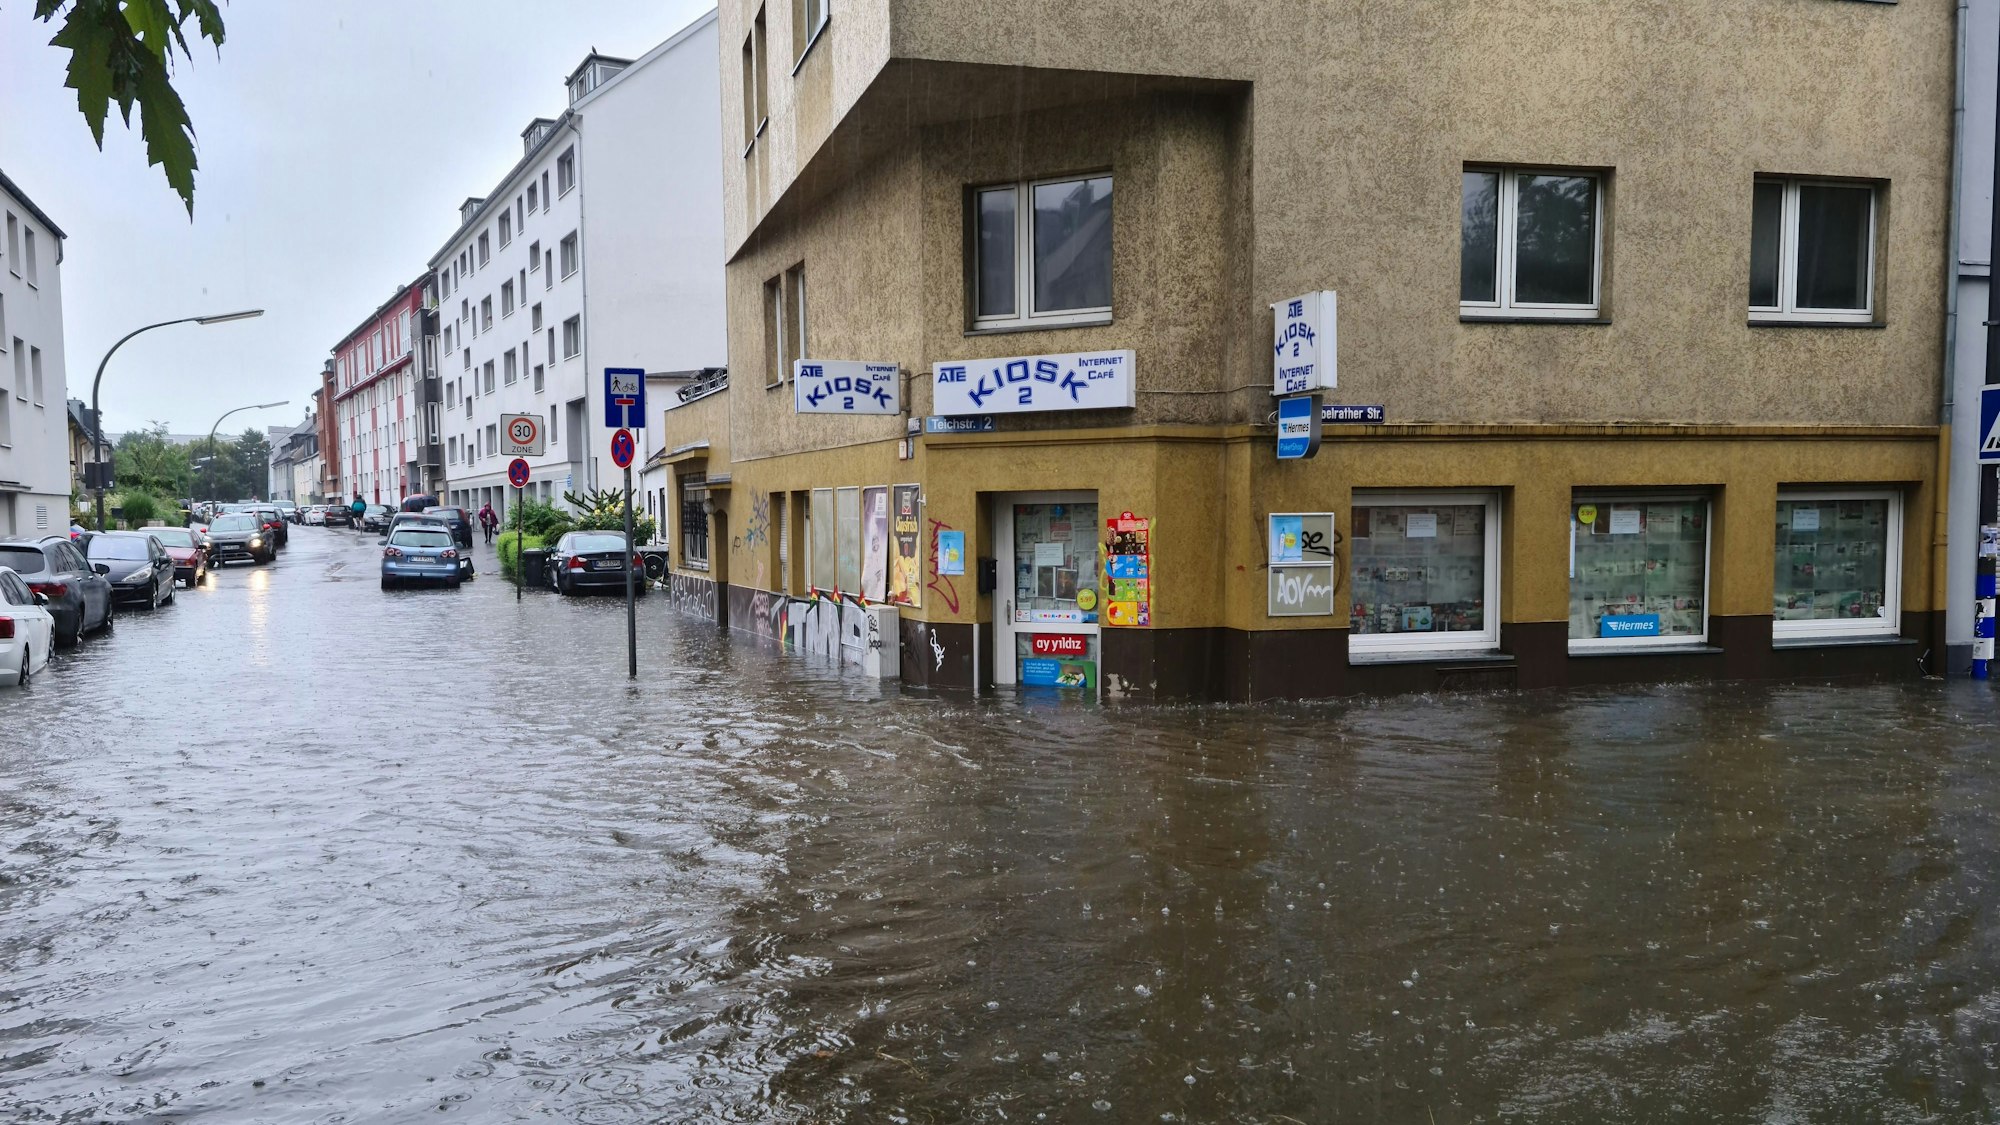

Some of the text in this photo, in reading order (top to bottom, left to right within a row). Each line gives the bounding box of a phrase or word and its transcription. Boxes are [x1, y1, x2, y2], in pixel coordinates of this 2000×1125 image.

[1287, 299, 1303, 319] ATE
[1275, 322, 1316, 357] KIOSK
[1293, 342, 1300, 357] 2
[1078, 356, 1124, 367] INTERNET
[800, 365, 823, 377] ATE
[938, 366, 967, 383] ATE
[1279, 364, 1314, 380] INTERNET
[968, 359, 1090, 408] KIOSK
[806, 377, 893, 409] KIOSK
[1018, 386, 1033, 405] 2
[843, 397, 854, 409] 2
[1367, 407, 1382, 420] Str.
[931, 416, 992, 430] Teichstr. 2
[1287, 423, 1309, 433] Hermes
[514, 425, 531, 438] 30
[1618, 621, 1654, 631] Hermes
[1036, 637, 1082, 652] ay yıldız
